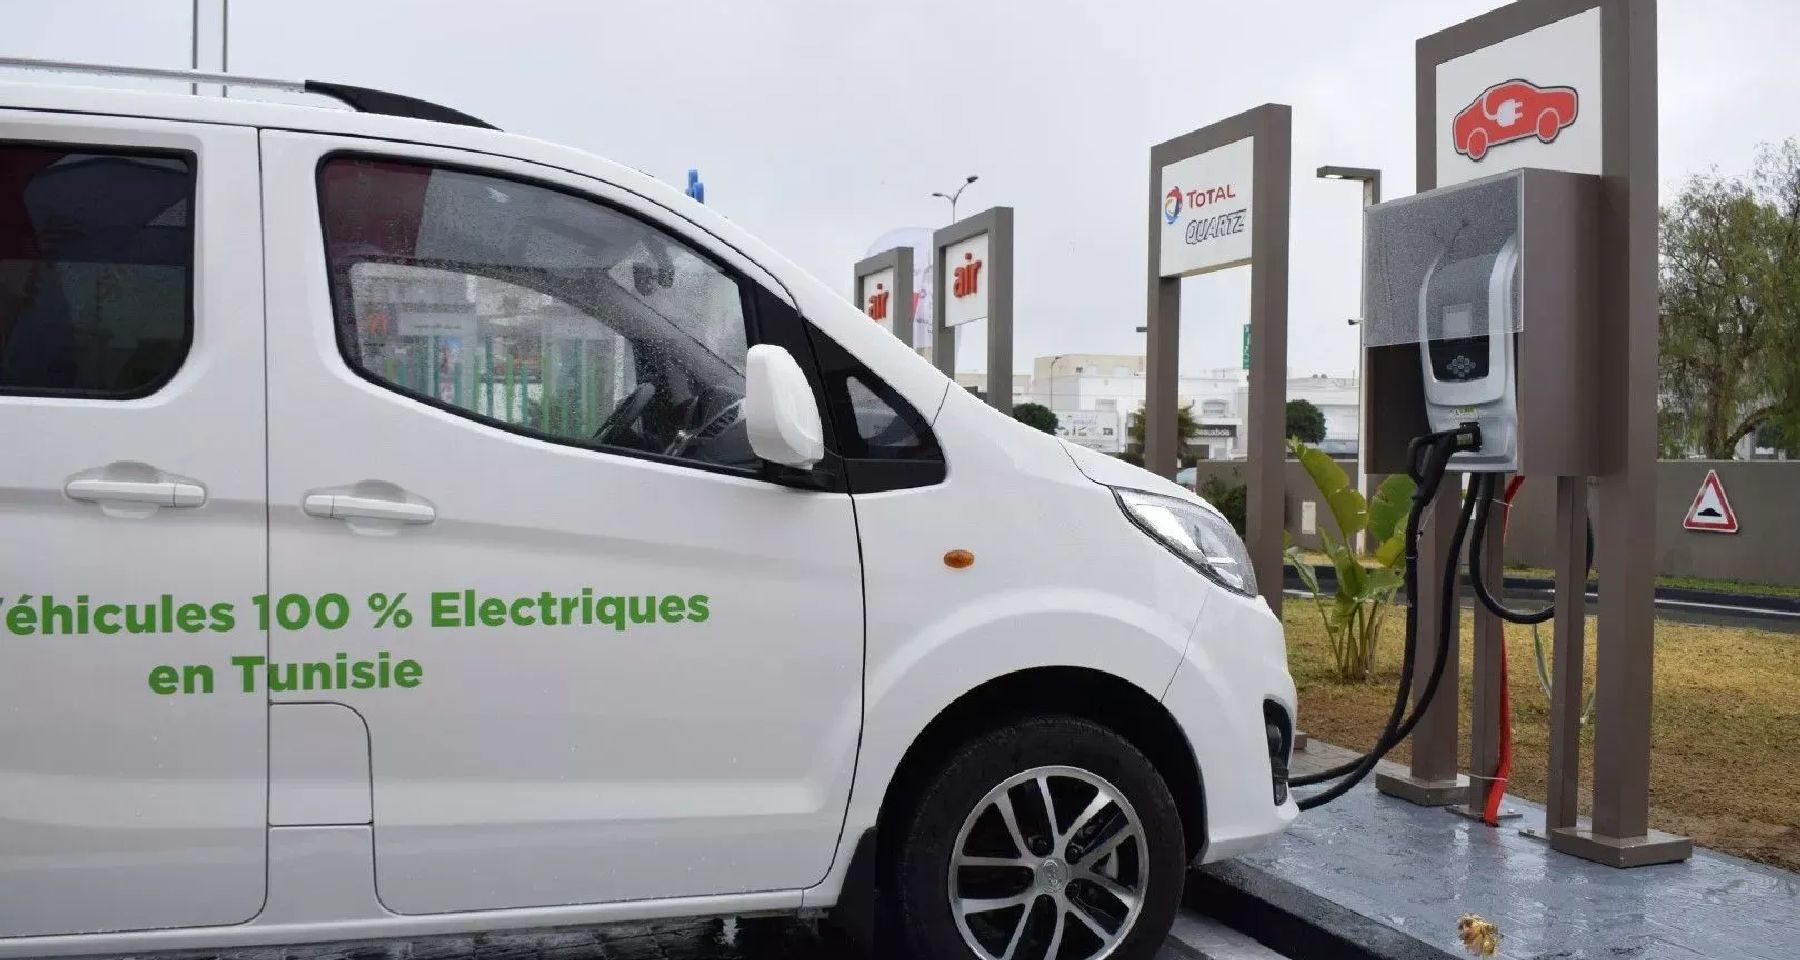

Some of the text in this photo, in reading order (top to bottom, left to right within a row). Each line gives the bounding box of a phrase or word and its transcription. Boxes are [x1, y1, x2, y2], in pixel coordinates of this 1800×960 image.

[1187, 184, 1236, 208] TOTAL
[1185, 209, 1247, 245] QUARTZ
[953, 252, 982, 298] air
[869, 283, 889, 320] air
[0, 587, 710, 635] éhicules 100 % Electriques
[148, 651, 424, 695] en Tunisie
